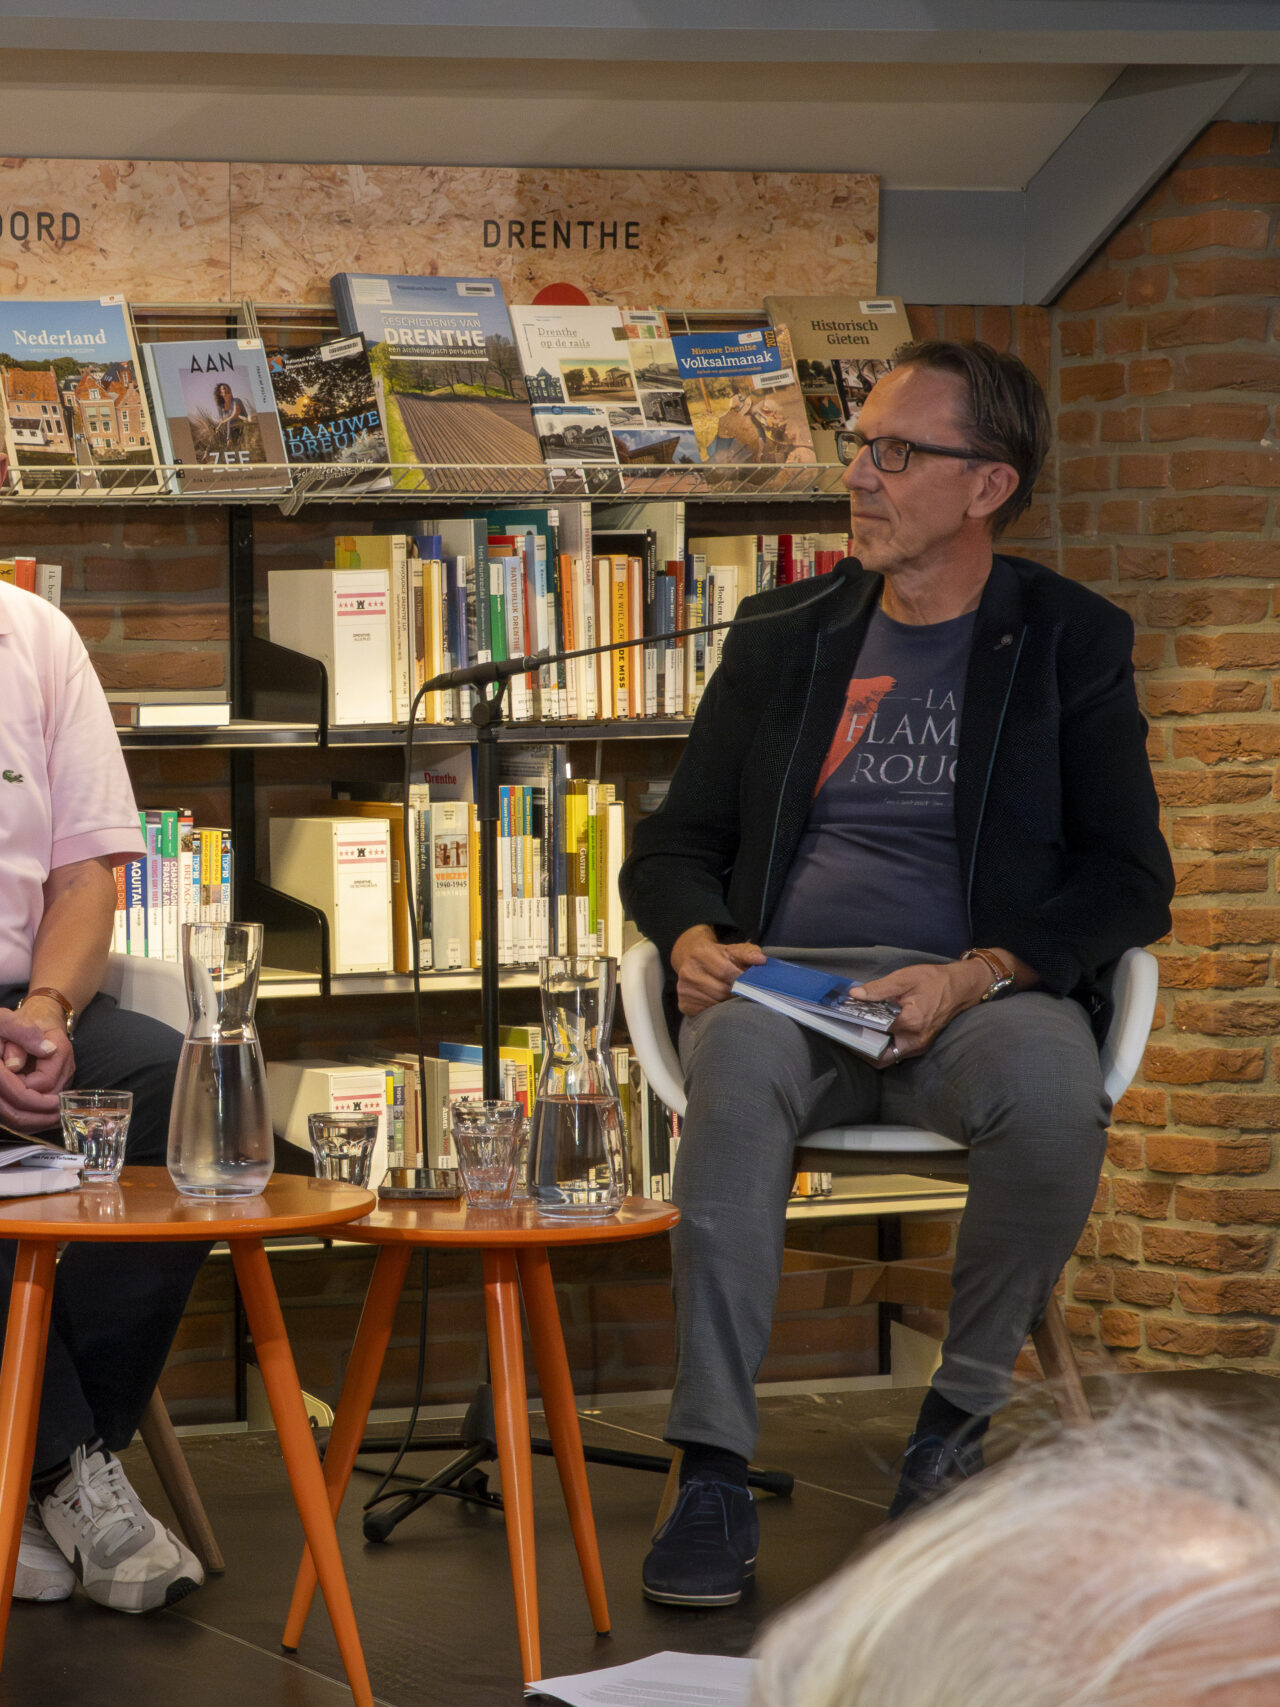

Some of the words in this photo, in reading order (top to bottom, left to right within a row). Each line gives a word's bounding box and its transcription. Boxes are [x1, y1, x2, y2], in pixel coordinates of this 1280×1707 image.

[482, 219, 642, 251] DRENTHE
[382, 316, 457, 329] GESCHIEDENIS
[460, 317, 482, 328] VAN
[537, 326, 578, 338] Drenthe
[811, 318, 879, 333] Historisch
[12, 328, 108, 347] Nederland
[383, 327, 487, 348] DRENTHE
[540, 339, 556, 349] op
[557, 338, 568, 348] de
[570, 337, 591, 349] rails
[827, 333, 870, 346] Gieten
[681, 352, 774, 370] Volksalmanak
[690, 346, 723, 357] Nieuwe
[190, 351, 235, 374] AAN
[288, 428, 370, 456] DREUM
[477, 545, 485, 559] Het
[510, 566, 520, 614] NATUURLIJK
[717, 585, 725, 616] Boeken
[511, 615, 521, 651] DRENTHE
[618, 649, 625, 662] DE
[618, 664, 626, 689] MISS
[925, 688, 957, 711] LA
[845, 712, 959, 747] FLAM
[423, 772, 457, 785] Drenthe
[579, 847, 587, 884] GASTEREN
[162, 861, 170, 893] FRANSE
[436, 881, 468, 889] 1940-1945
